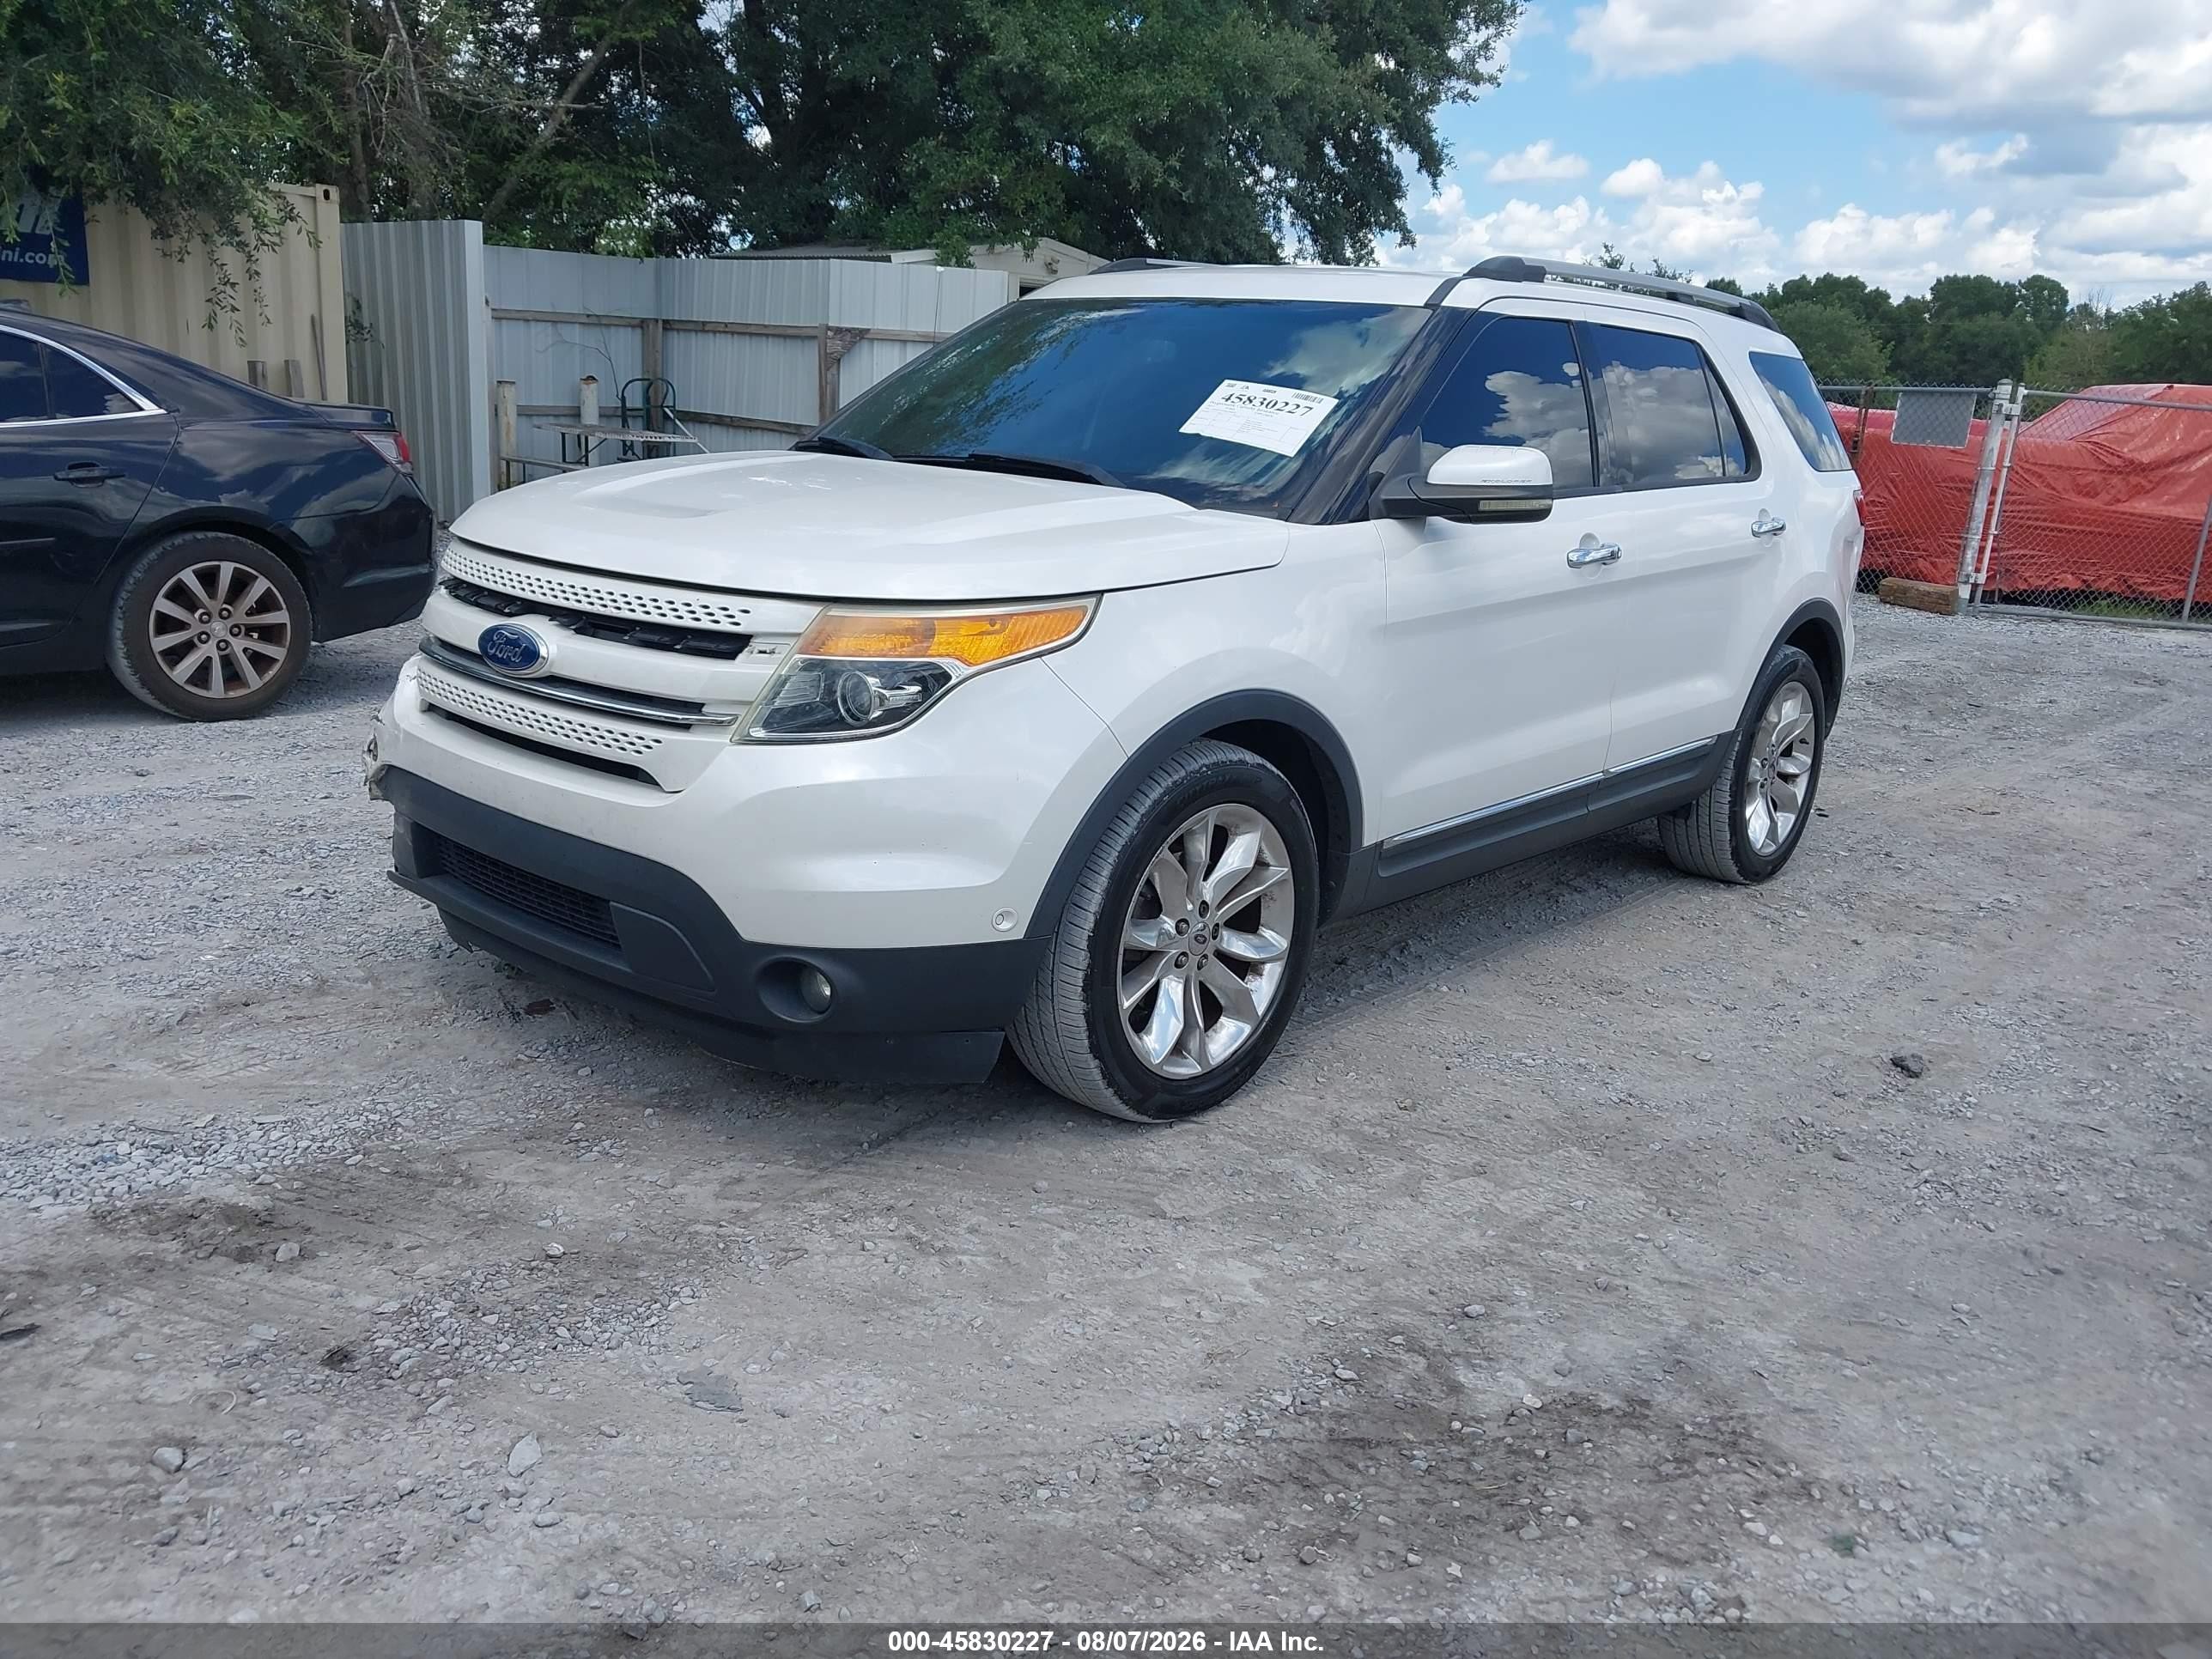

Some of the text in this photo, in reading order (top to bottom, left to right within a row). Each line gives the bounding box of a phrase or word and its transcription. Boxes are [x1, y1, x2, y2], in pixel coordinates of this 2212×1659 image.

[0, 246, 65, 265] ni.com
[1221, 392, 1315, 417] 45830227
[487, 629, 526, 663] Ford
